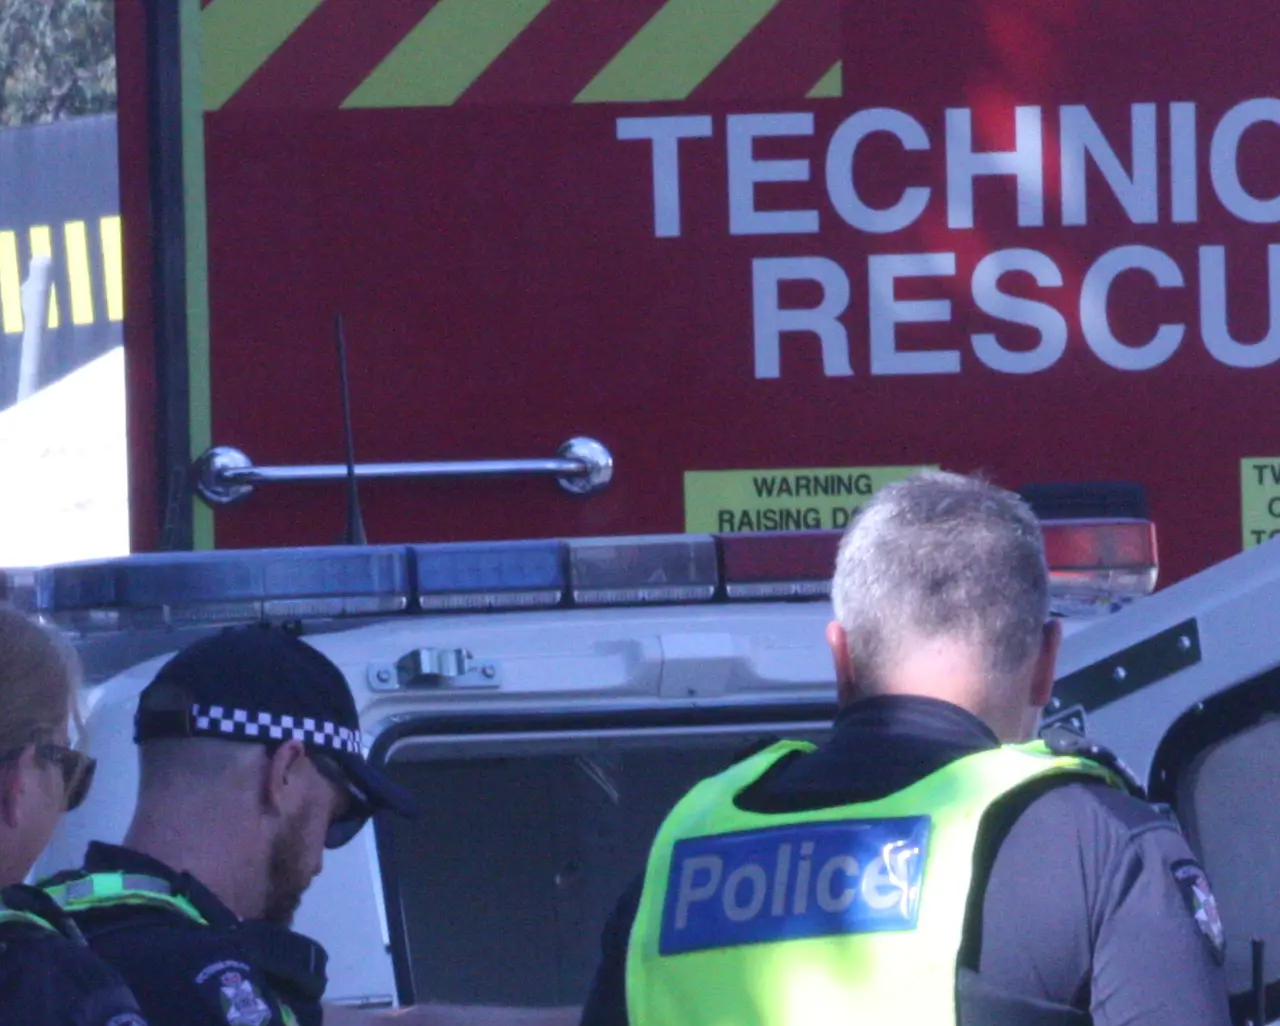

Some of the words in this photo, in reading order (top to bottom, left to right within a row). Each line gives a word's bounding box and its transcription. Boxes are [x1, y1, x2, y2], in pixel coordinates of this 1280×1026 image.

[753, 473, 873, 498] WARNING
[717, 507, 821, 532] RAISING
[673, 842, 918, 930] Police
